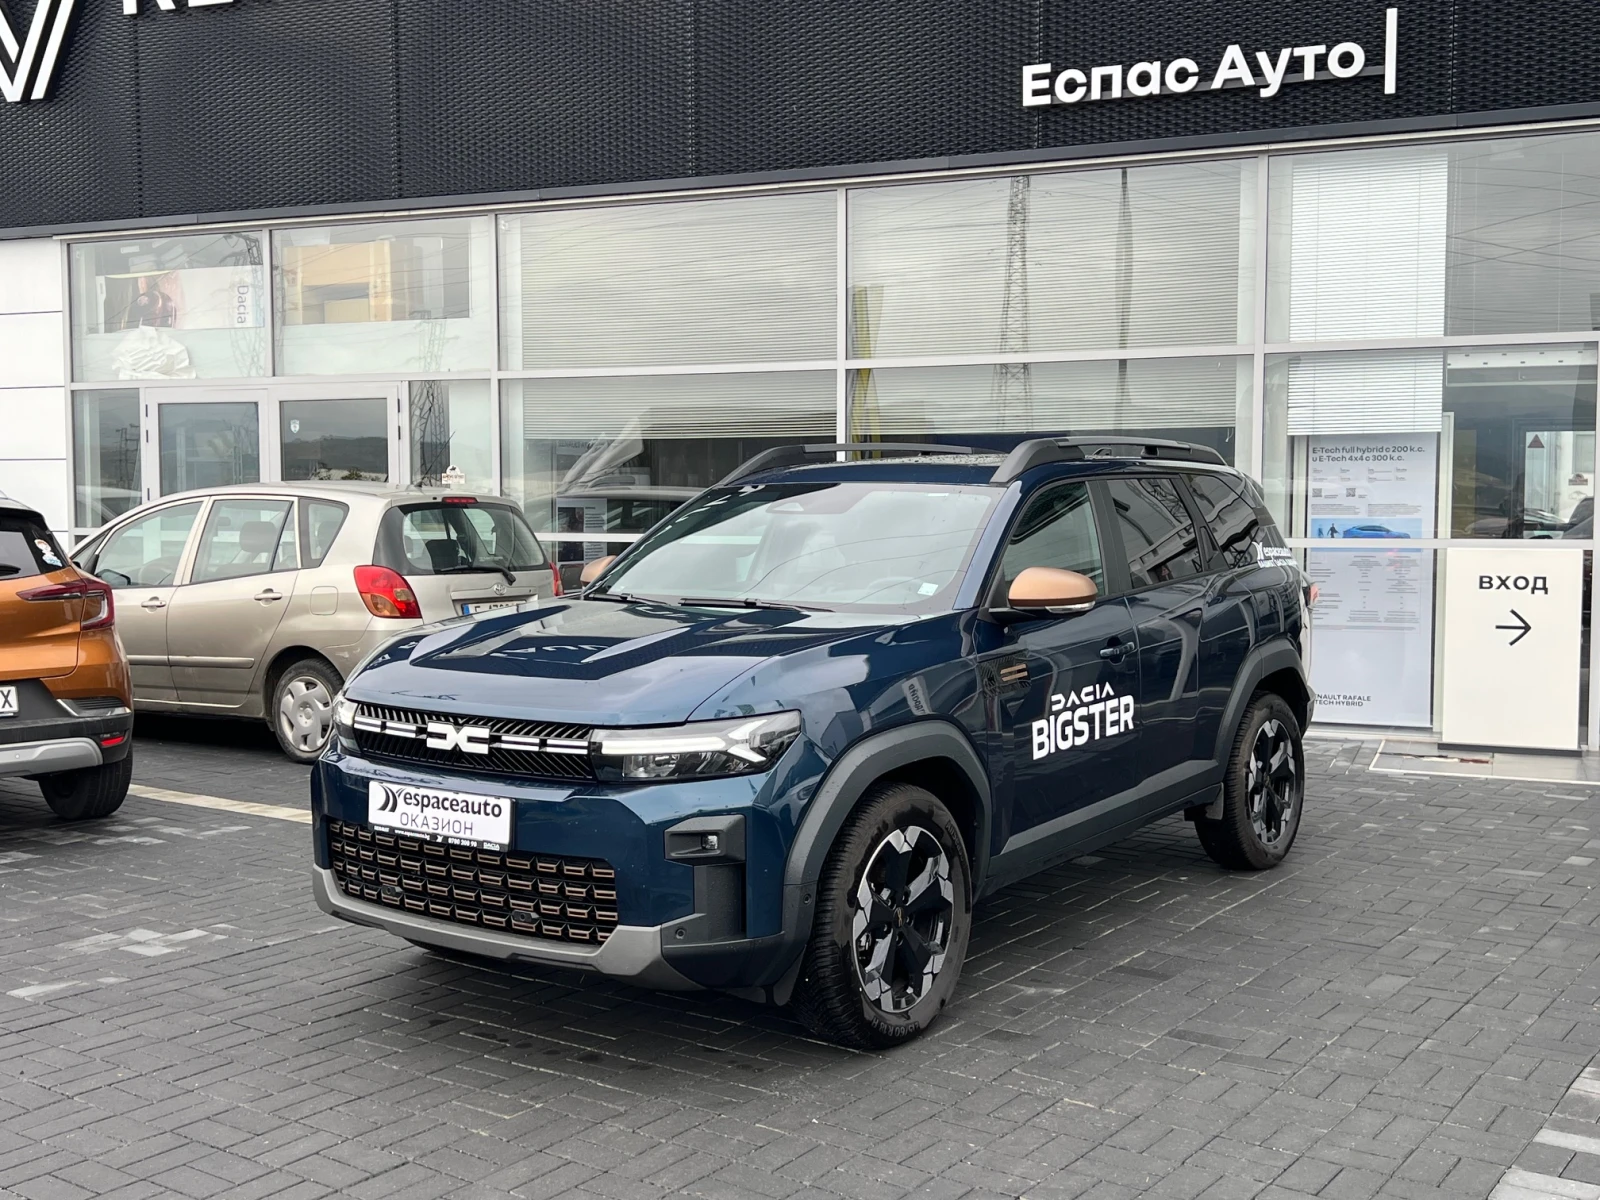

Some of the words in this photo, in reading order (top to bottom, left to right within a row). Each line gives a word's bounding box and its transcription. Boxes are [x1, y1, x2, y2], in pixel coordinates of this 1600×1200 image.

[1022, 57, 1199, 107] Еспас
[1210, 41, 1366, 98] Ауто
[237, 285, 249, 324] Dacia
[1312, 446, 1341, 454] E-Tech
[1341, 445, 1355, 453] full
[1356, 445, 1384, 455] hybrid
[1392, 445, 1409, 453] 200
[1371, 454, 1388, 462] 300
[1478, 575, 1548, 595] ВХОД
[1051, 681, 1114, 711] DACIA
[1032, 695, 1134, 760] BIGSTER
[403, 791, 503, 819] espaceauto
[400, 812, 474, 837] ОКАЗИОН
